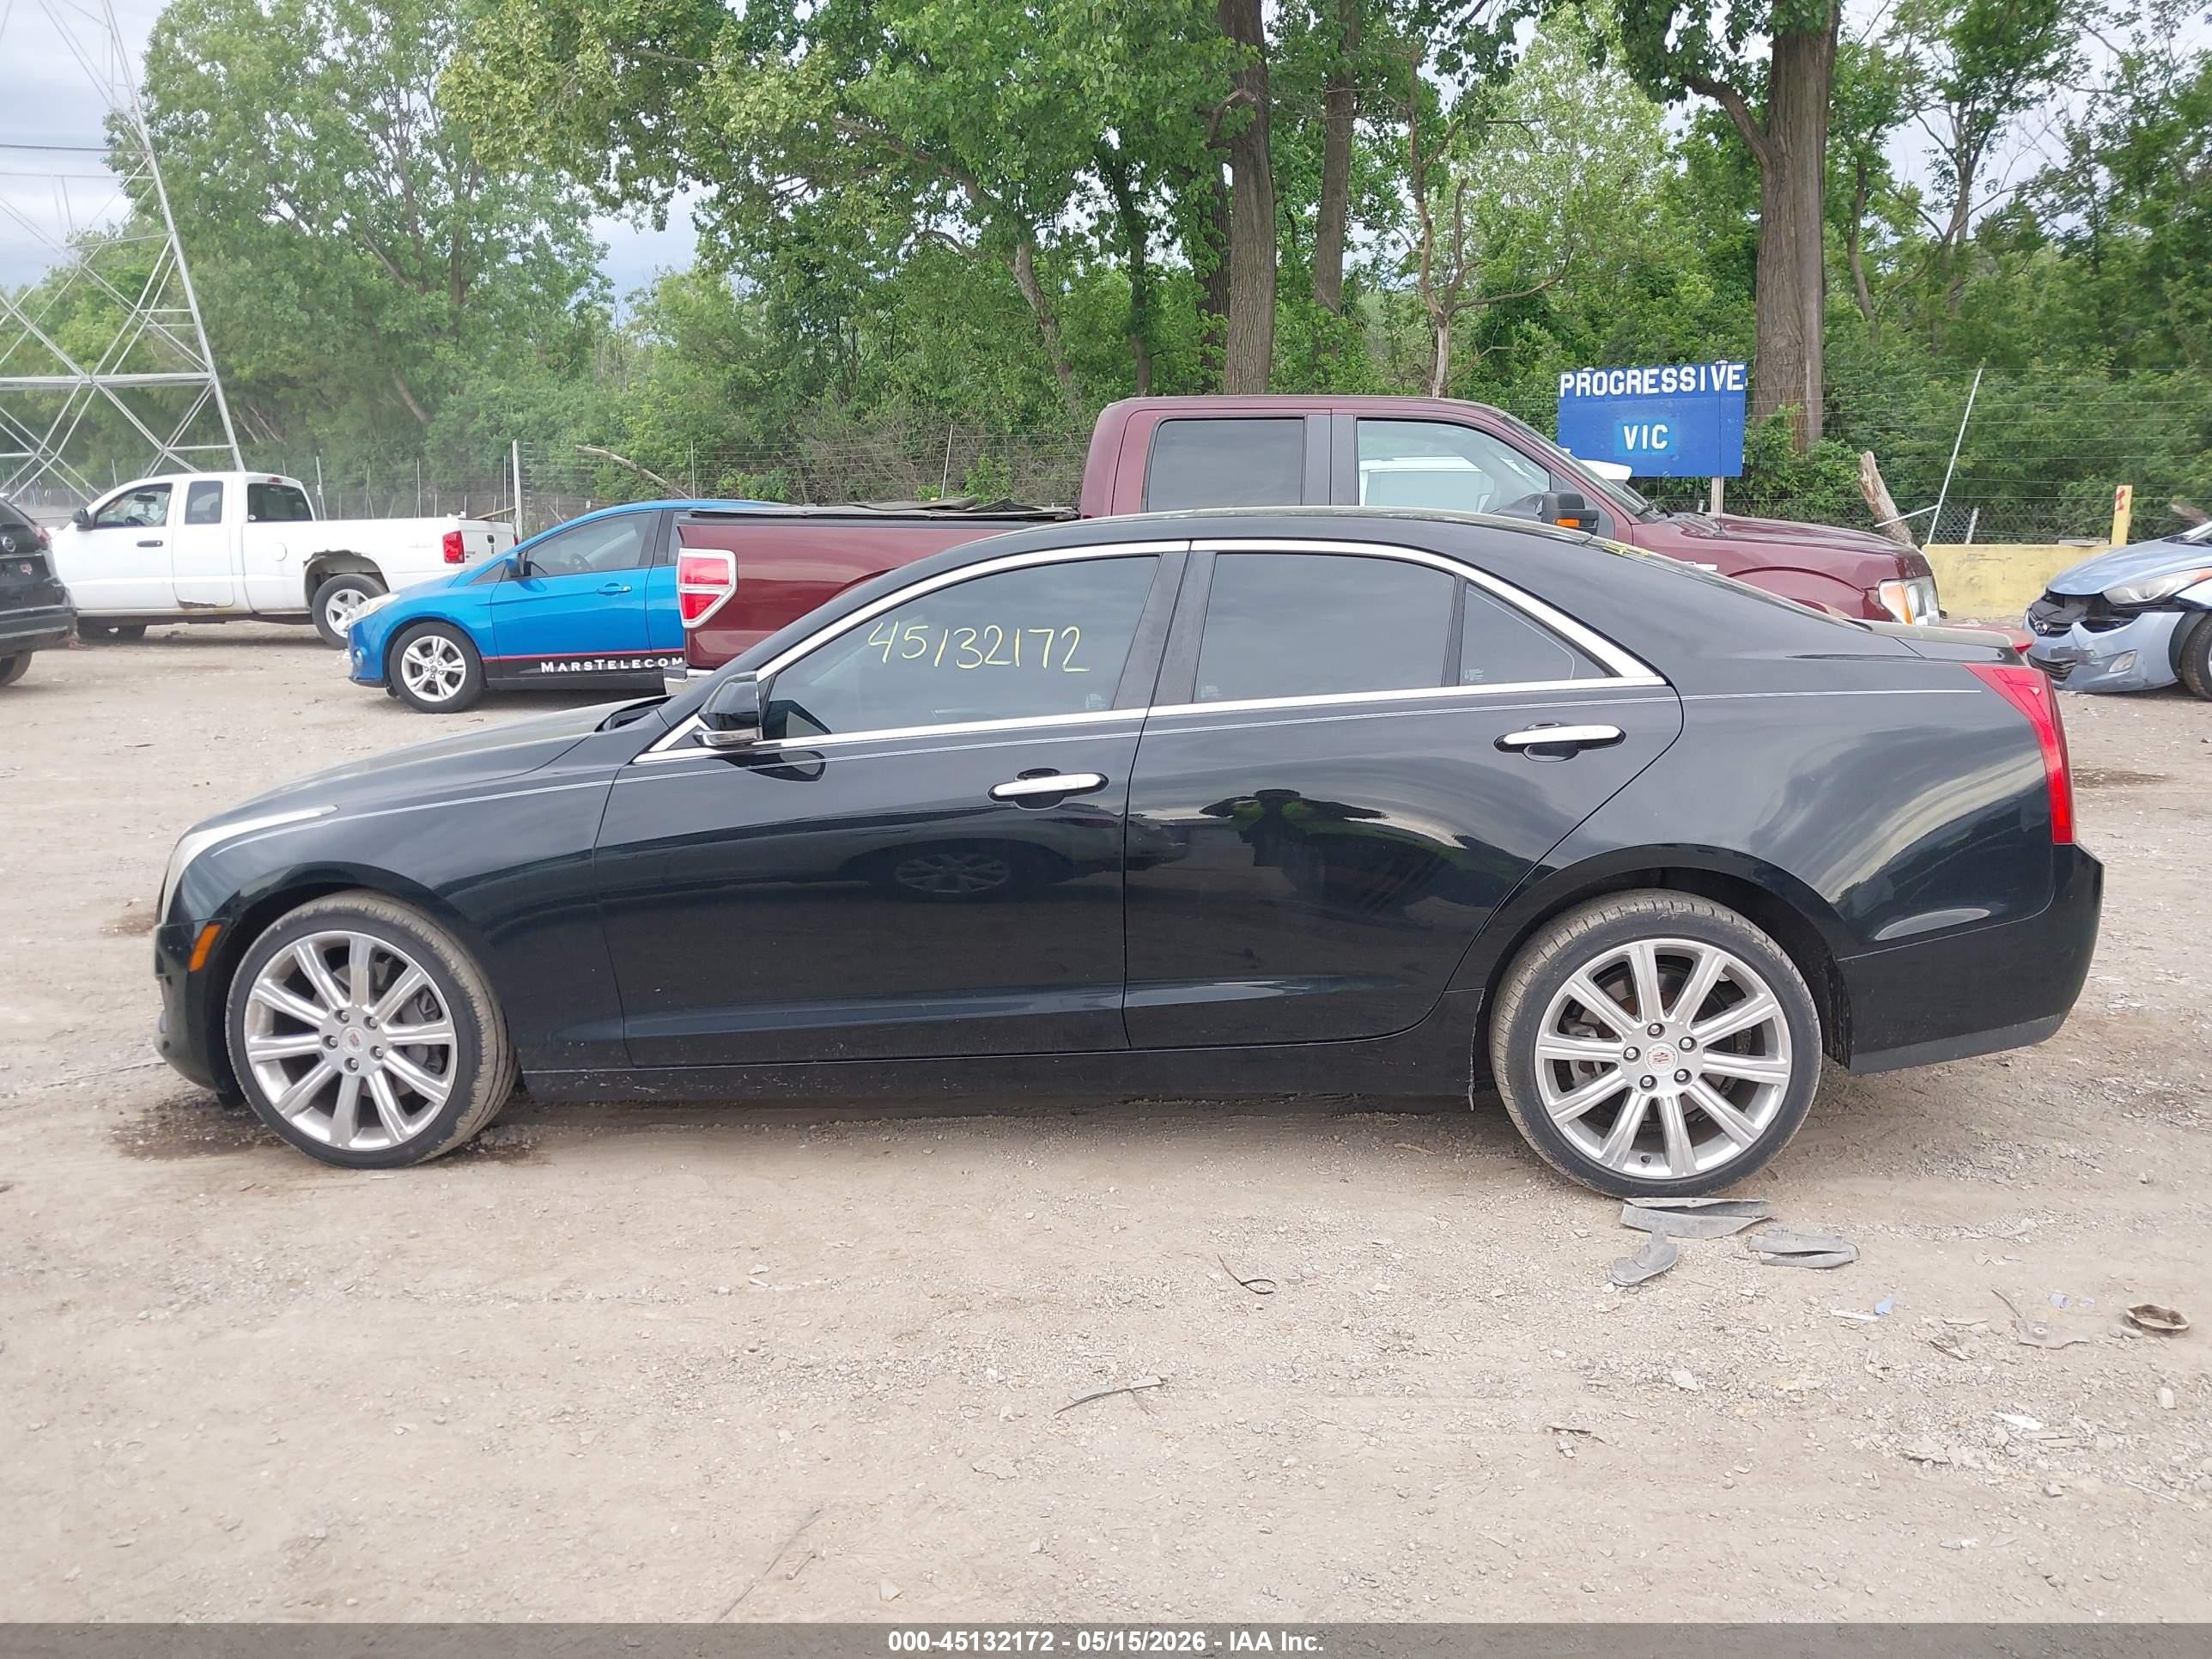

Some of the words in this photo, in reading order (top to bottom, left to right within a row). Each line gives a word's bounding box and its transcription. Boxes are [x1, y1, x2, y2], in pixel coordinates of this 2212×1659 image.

[1559, 364, 1746, 398] PROGRESSIVE
[1623, 424, 1668, 450] VIC
[868, 621, 1091, 672] 45132172
